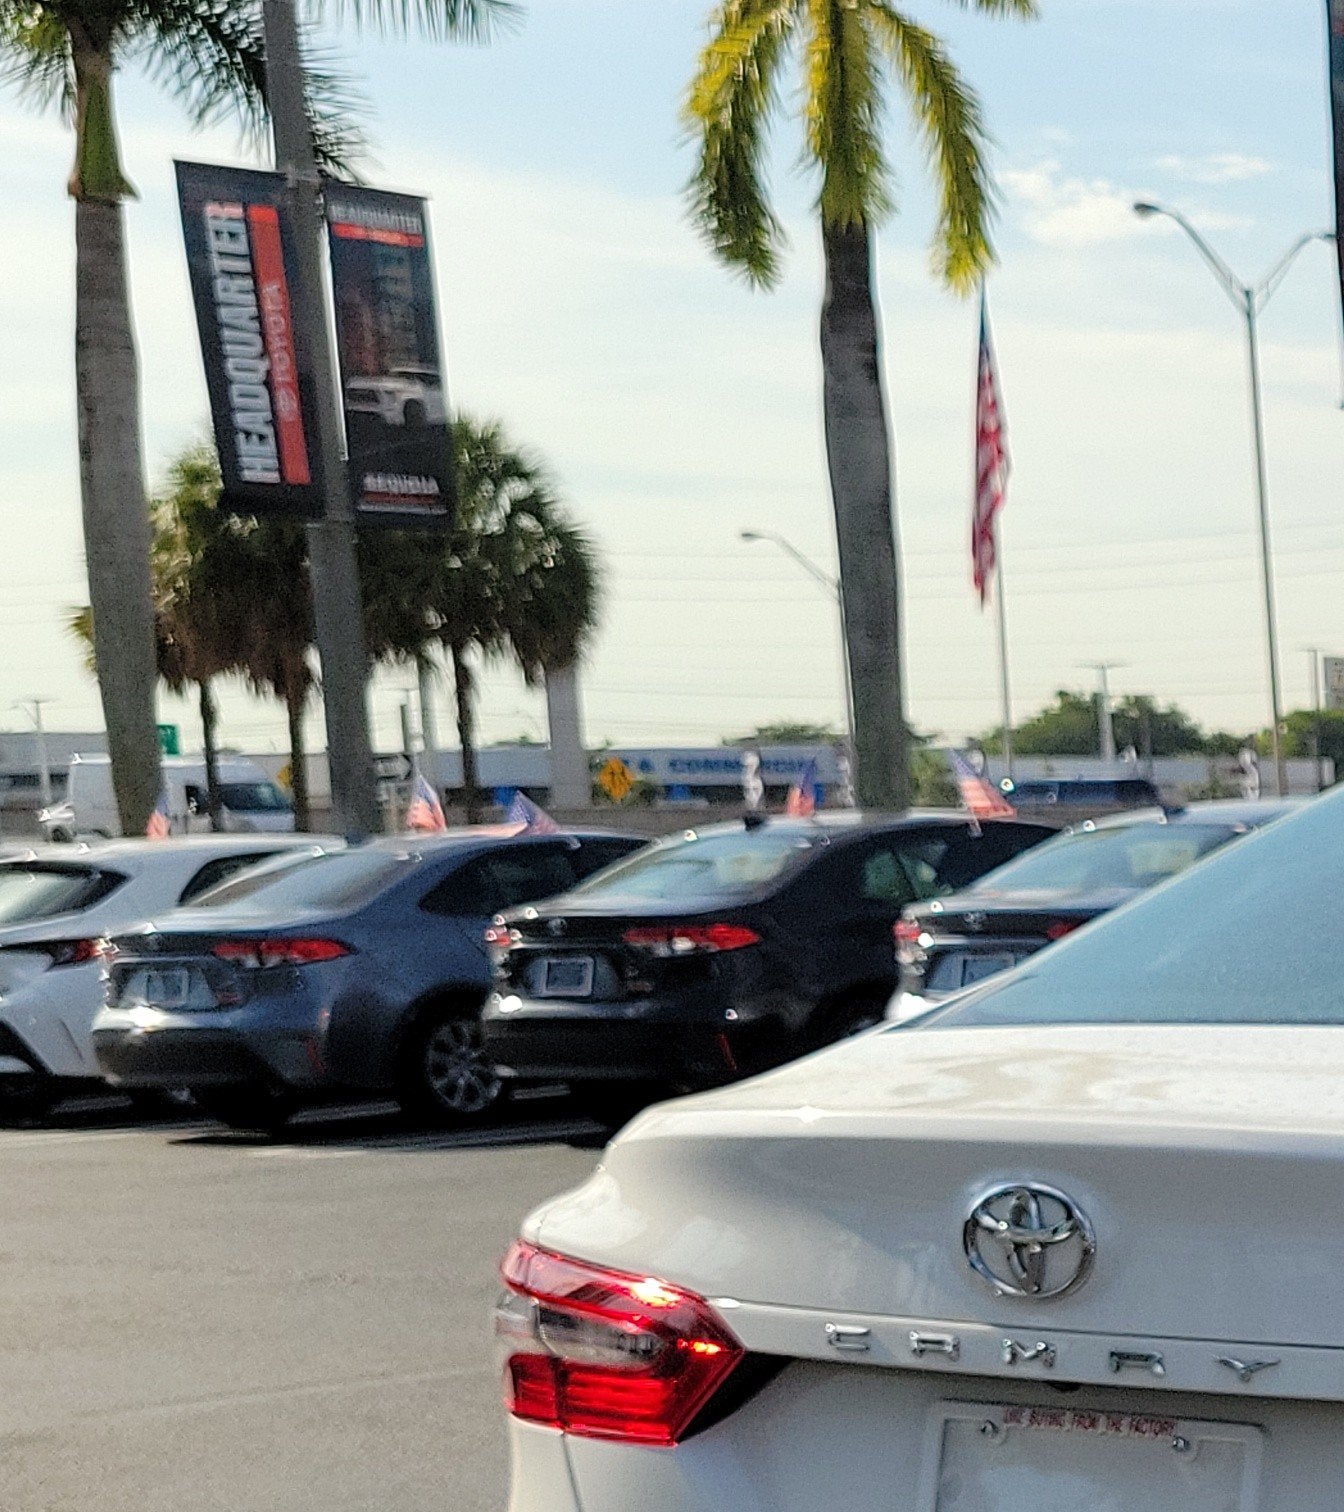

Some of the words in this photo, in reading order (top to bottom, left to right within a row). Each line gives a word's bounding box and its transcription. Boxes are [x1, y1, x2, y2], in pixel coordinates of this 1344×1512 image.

[205, 202, 281, 483] HEADQUARTER
[263, 282, 297, 388] TOYOTA
[824, 1322, 1281, 1383] CAMRY
